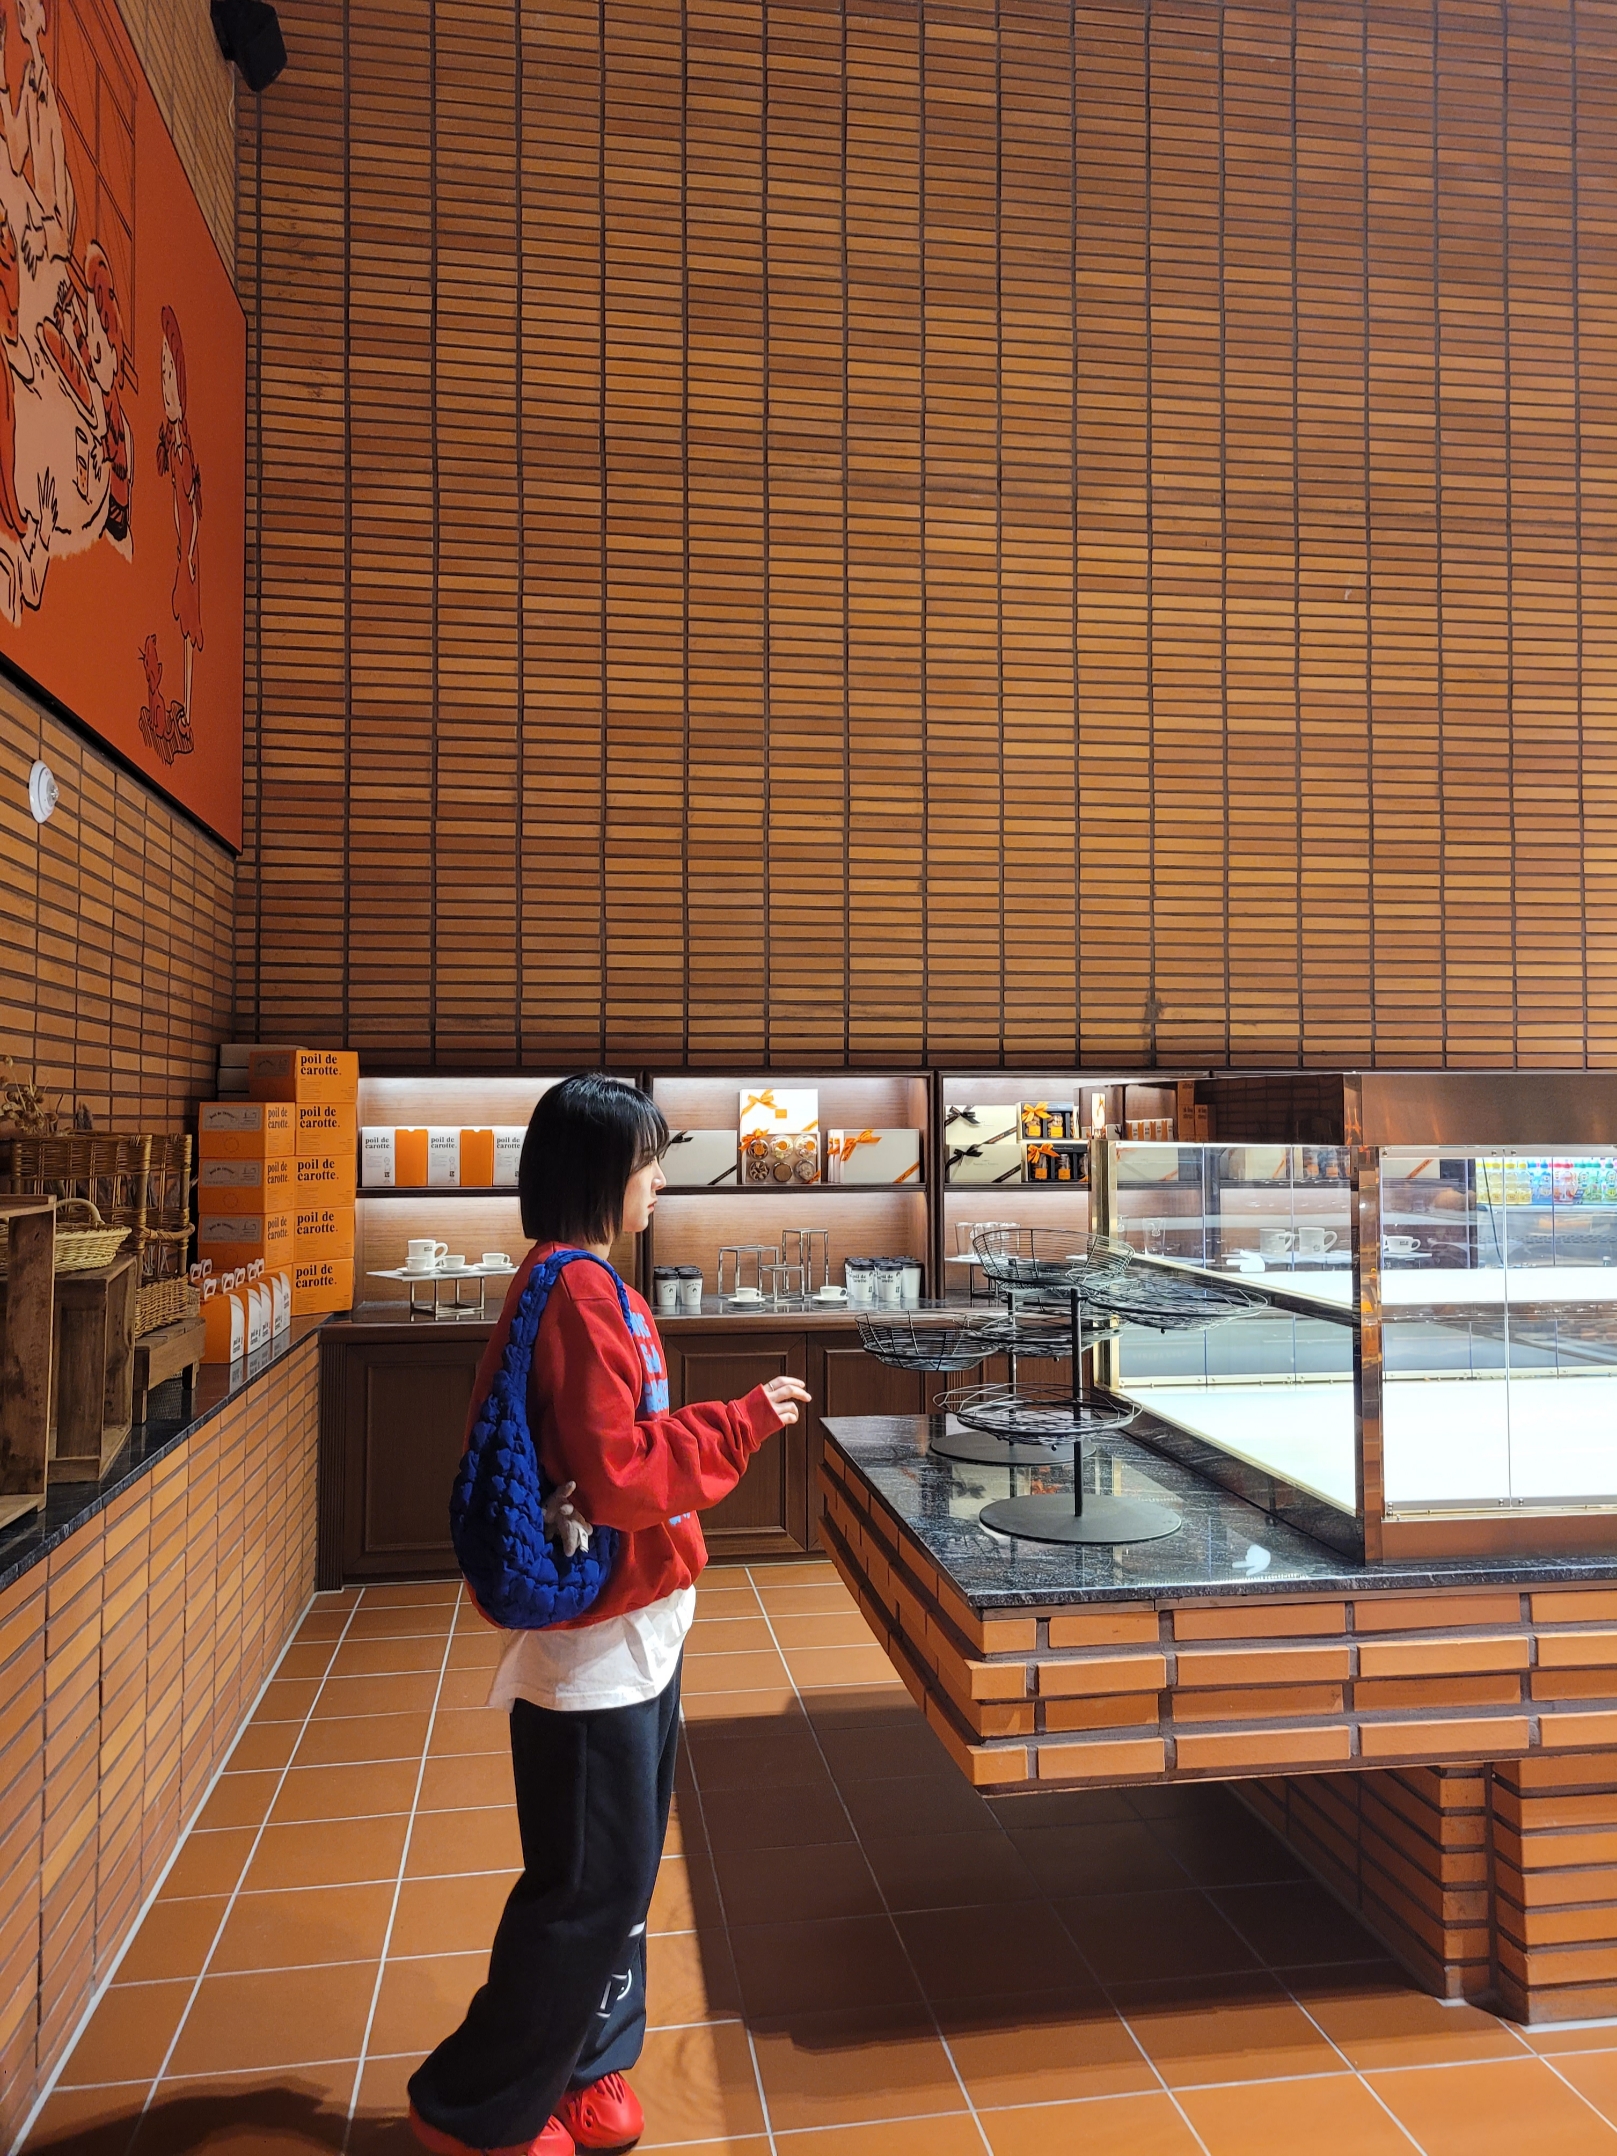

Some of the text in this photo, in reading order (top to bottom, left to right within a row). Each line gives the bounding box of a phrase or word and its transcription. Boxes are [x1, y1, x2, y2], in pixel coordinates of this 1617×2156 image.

[300, 1053, 338, 1066] poil de
[300, 1066, 342, 1076] carotte.
[268, 1106, 288, 1120] poil de
[300, 1106, 336, 1120] poil de
[300, 1118, 340, 1128] carotte.
[267, 1161, 288, 1175] poil de
[297, 1158, 335, 1172] poil de
[297, 1170, 340, 1181] carotte.
[267, 1216, 288, 1230] poil de
[296, 1210, 334, 1226] poil de
[296, 1222, 338, 1235] carotte.
[296, 1264, 333, 1280] poil de
[295, 1276, 337, 1288] carotte.
